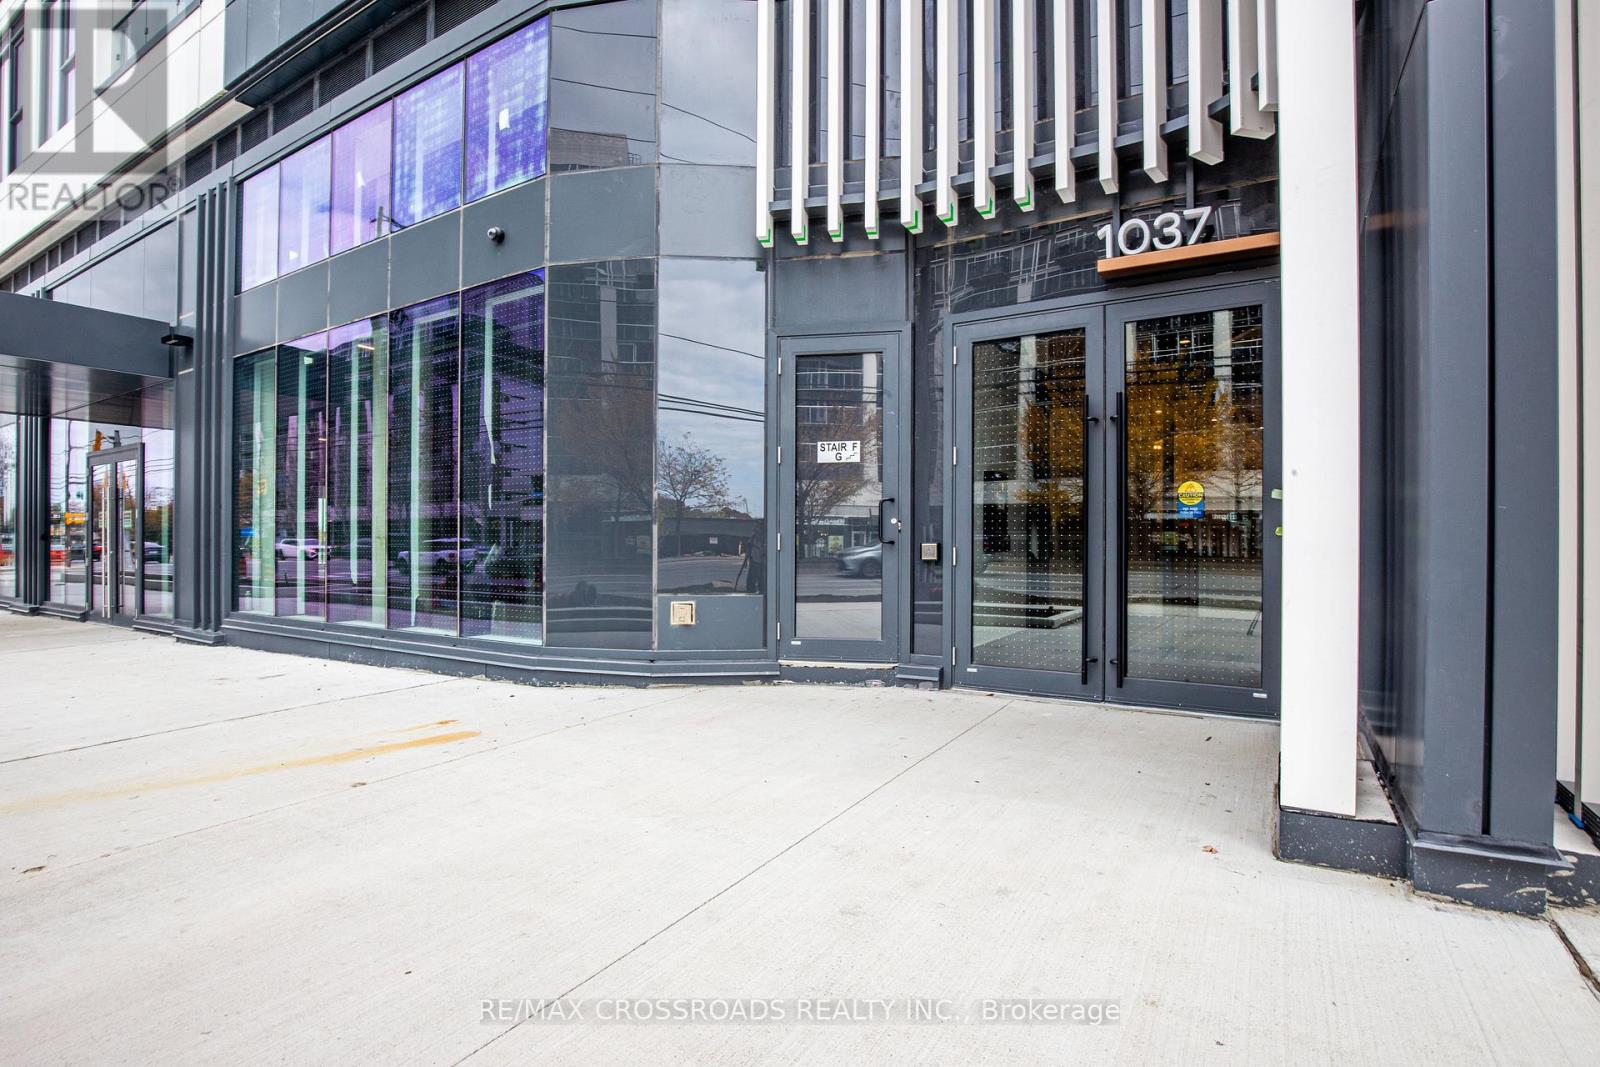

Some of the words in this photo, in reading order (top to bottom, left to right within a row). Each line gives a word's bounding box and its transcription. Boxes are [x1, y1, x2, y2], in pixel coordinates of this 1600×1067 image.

[1097, 206, 1212, 258] 1037
[819, 442, 847, 452] STAIR
[852, 442, 858, 452] F
[835, 452, 842, 461] G
